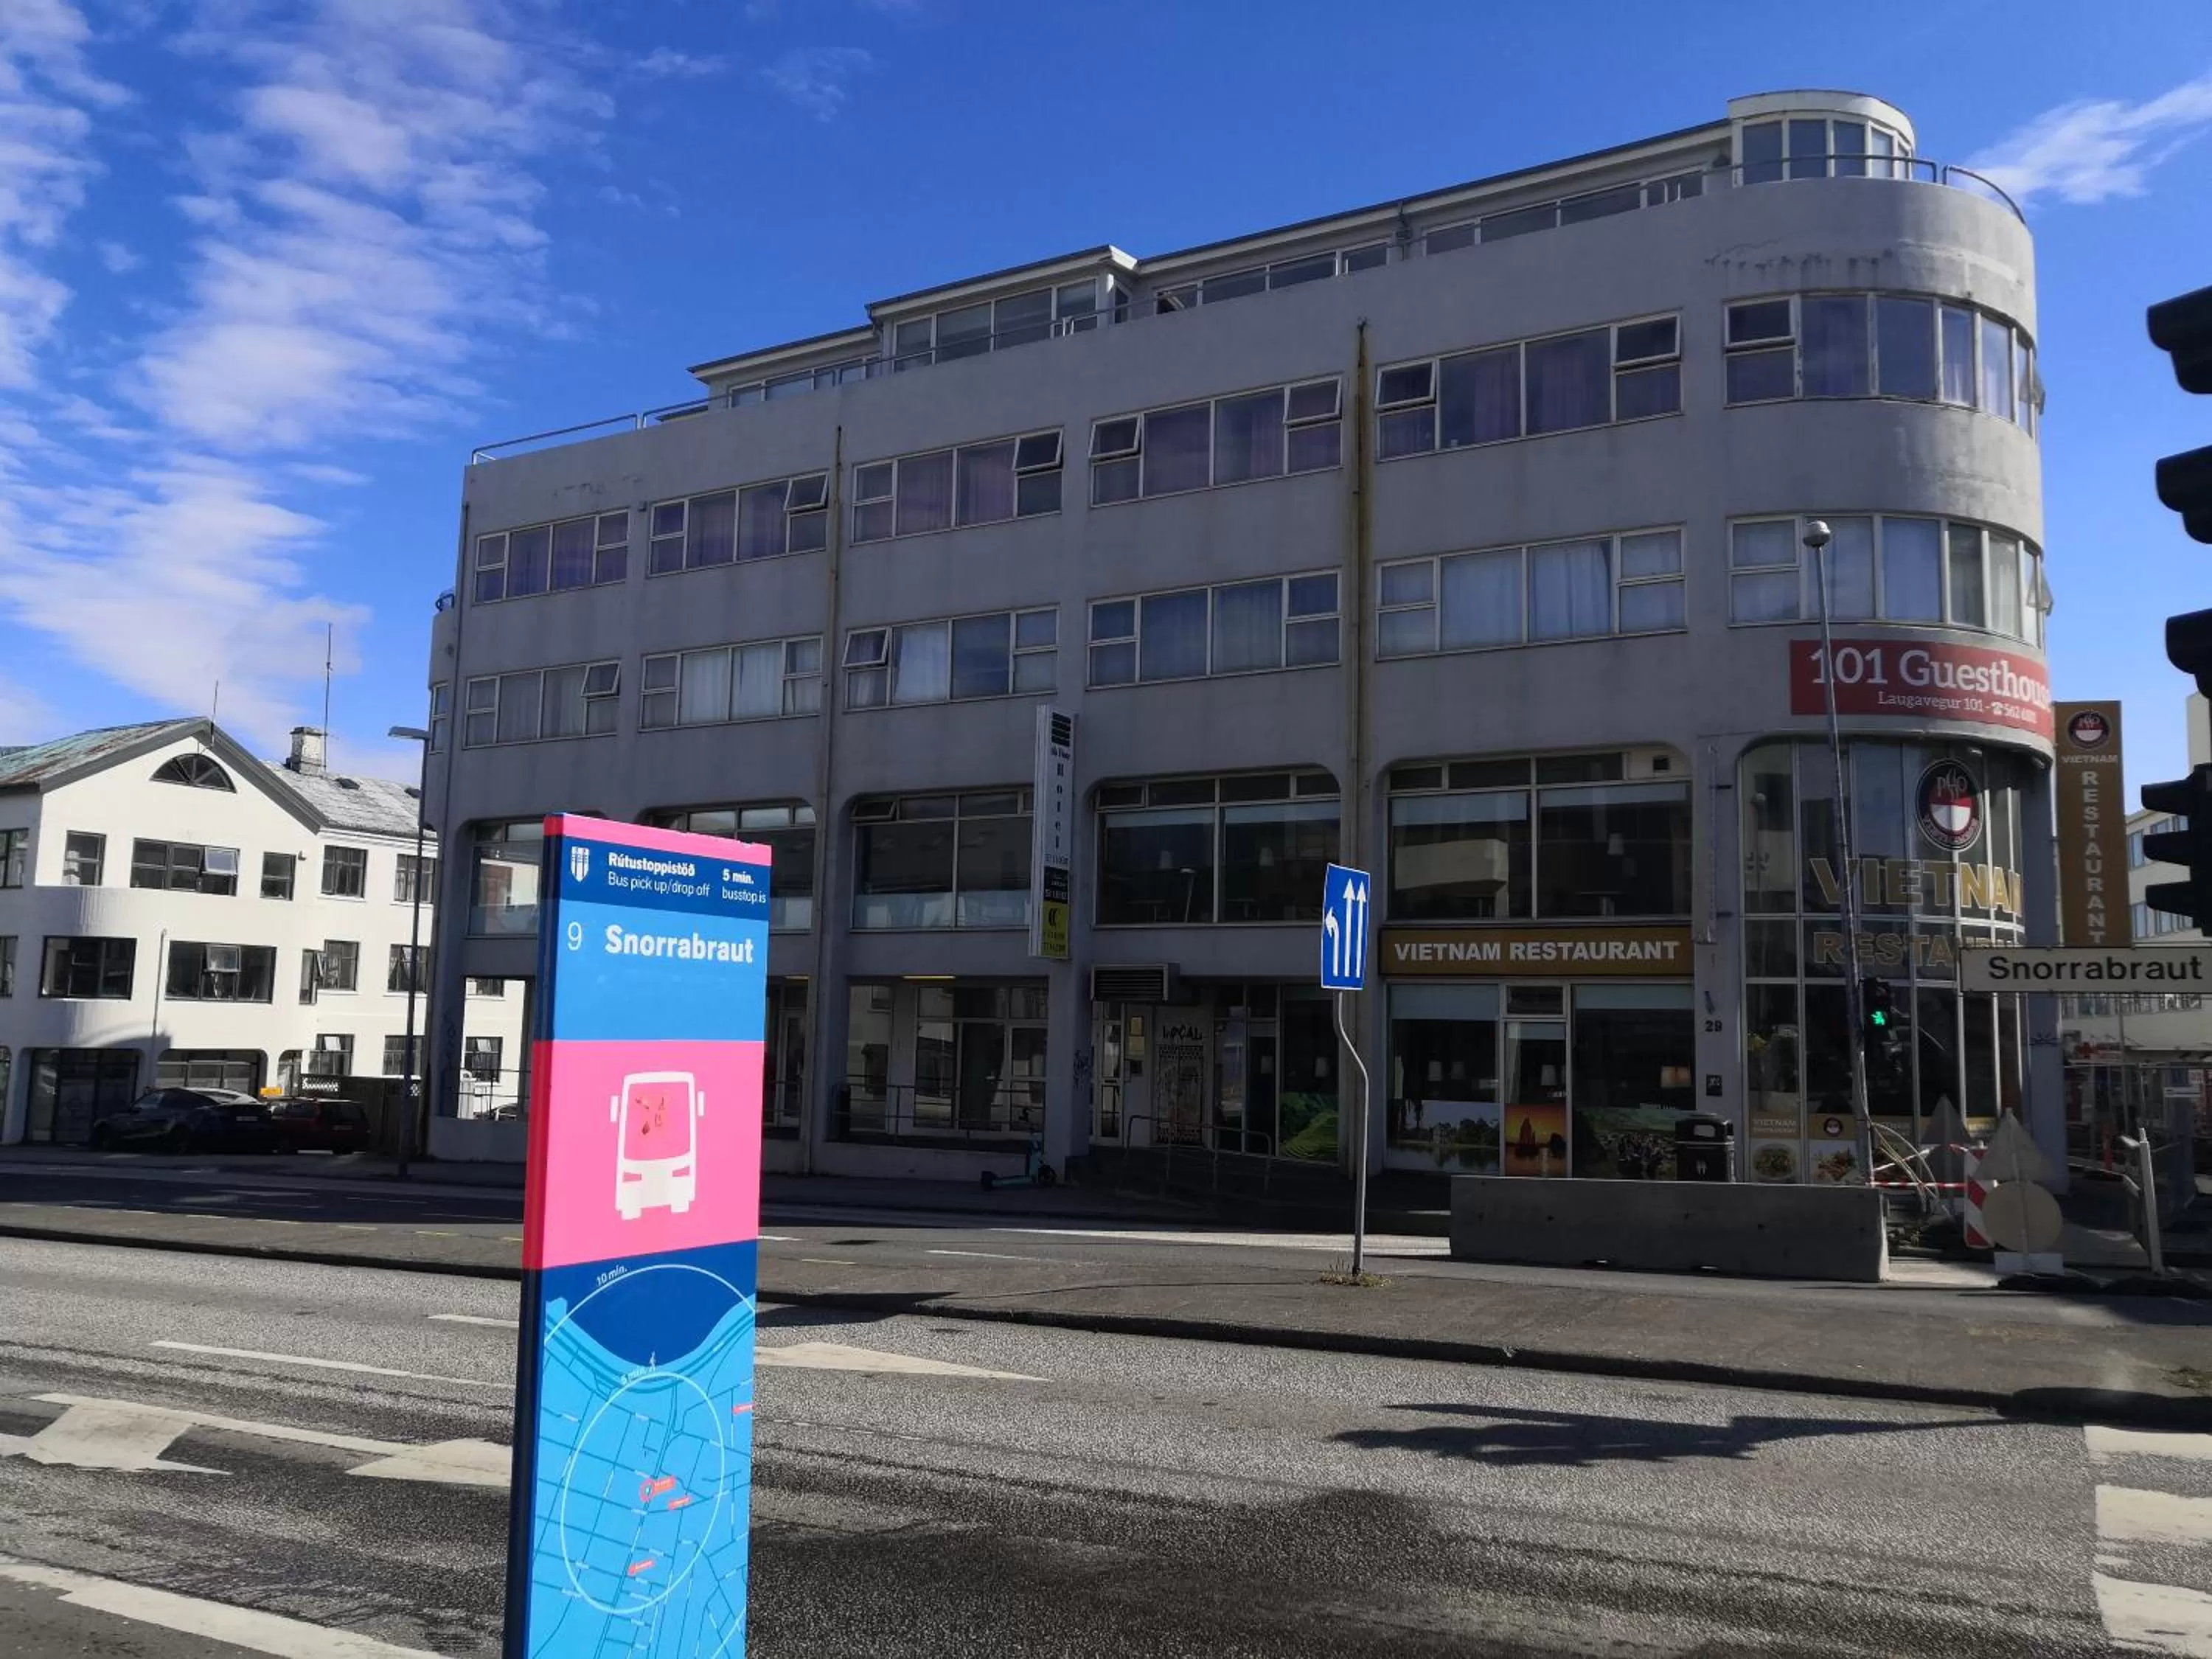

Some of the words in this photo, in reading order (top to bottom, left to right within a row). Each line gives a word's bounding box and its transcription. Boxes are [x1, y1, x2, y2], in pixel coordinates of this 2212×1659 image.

[1811, 647, 1888, 684] 101
[1877, 691, 1962, 709] Laugavegur
[1964, 698, 1983, 712] 101
[2062, 754, 2118, 765] VIETNAM
[608, 852, 695, 877] Rútustoppistöð
[723, 868, 730, 882] 5
[732, 871, 754, 885] min.
[2081, 771, 2106, 945] RESTAURANT
[608, 871, 629, 887] Bus
[630, 875, 652, 891] pick
[696, 883, 711, 897] off
[567, 921, 582, 950] 9
[605, 924, 754, 963] Snorrabraut
[1394, 942, 1500, 961] VIETNAM
[1509, 940, 1680, 961] RESTAURANT
[1989, 956, 2202, 980] Snorrabraut
[1705, 1020, 1723, 1032] 29
[597, 1272, 608, 1286] 10
[608, 1265, 627, 1280] min.
